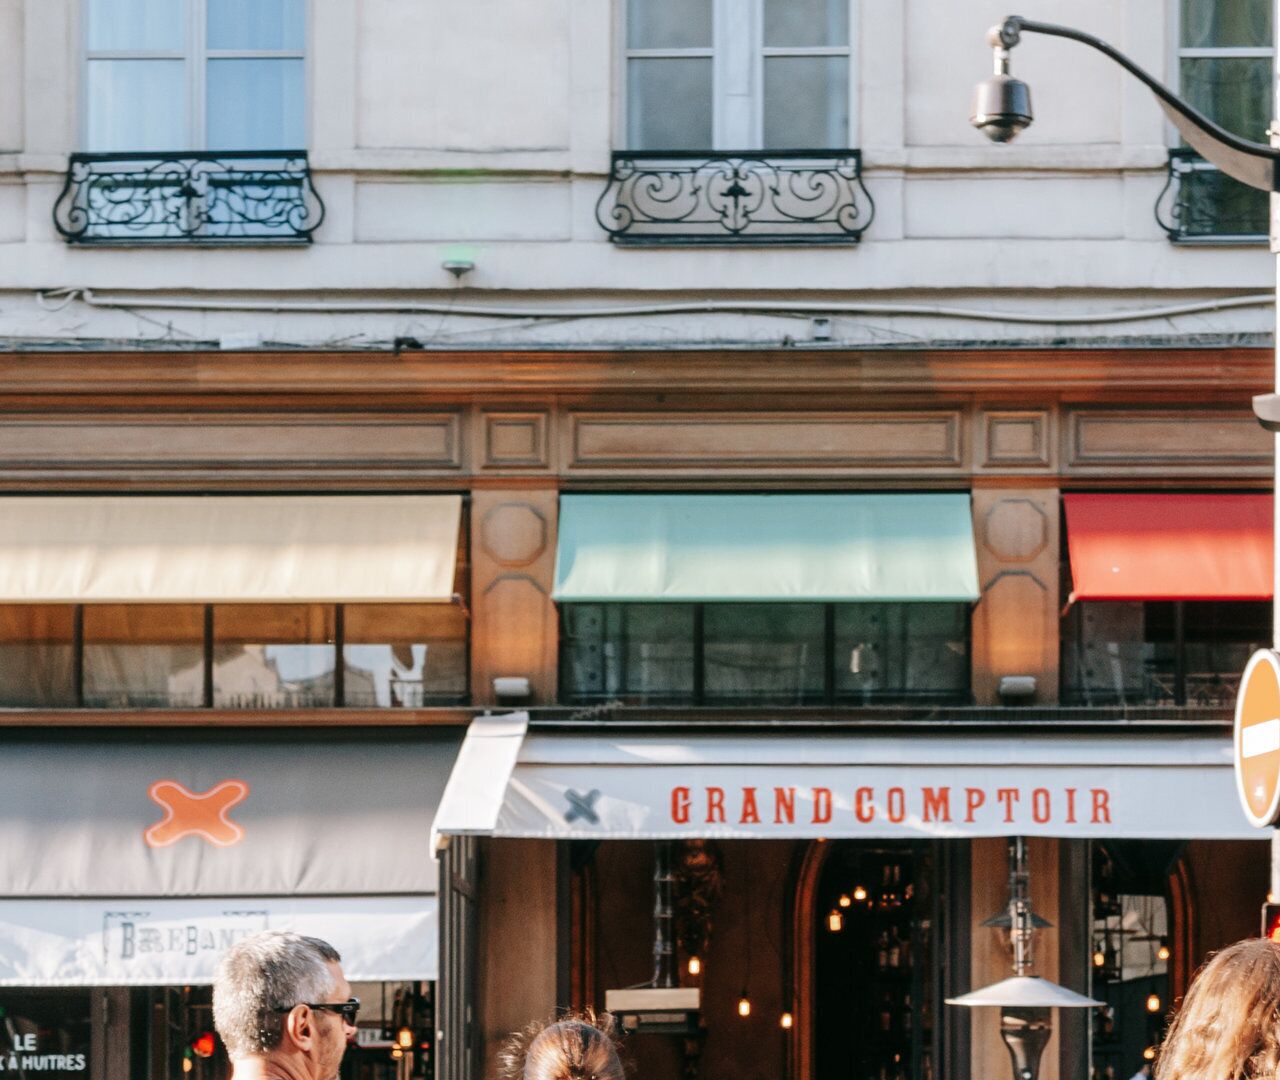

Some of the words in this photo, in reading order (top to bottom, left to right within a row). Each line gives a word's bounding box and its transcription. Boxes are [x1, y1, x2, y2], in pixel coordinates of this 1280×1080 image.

[670, 785, 834, 825] GRAND
[854, 786, 1113, 825] COMPTOIR
[14, 1034, 37, 1051] LE
